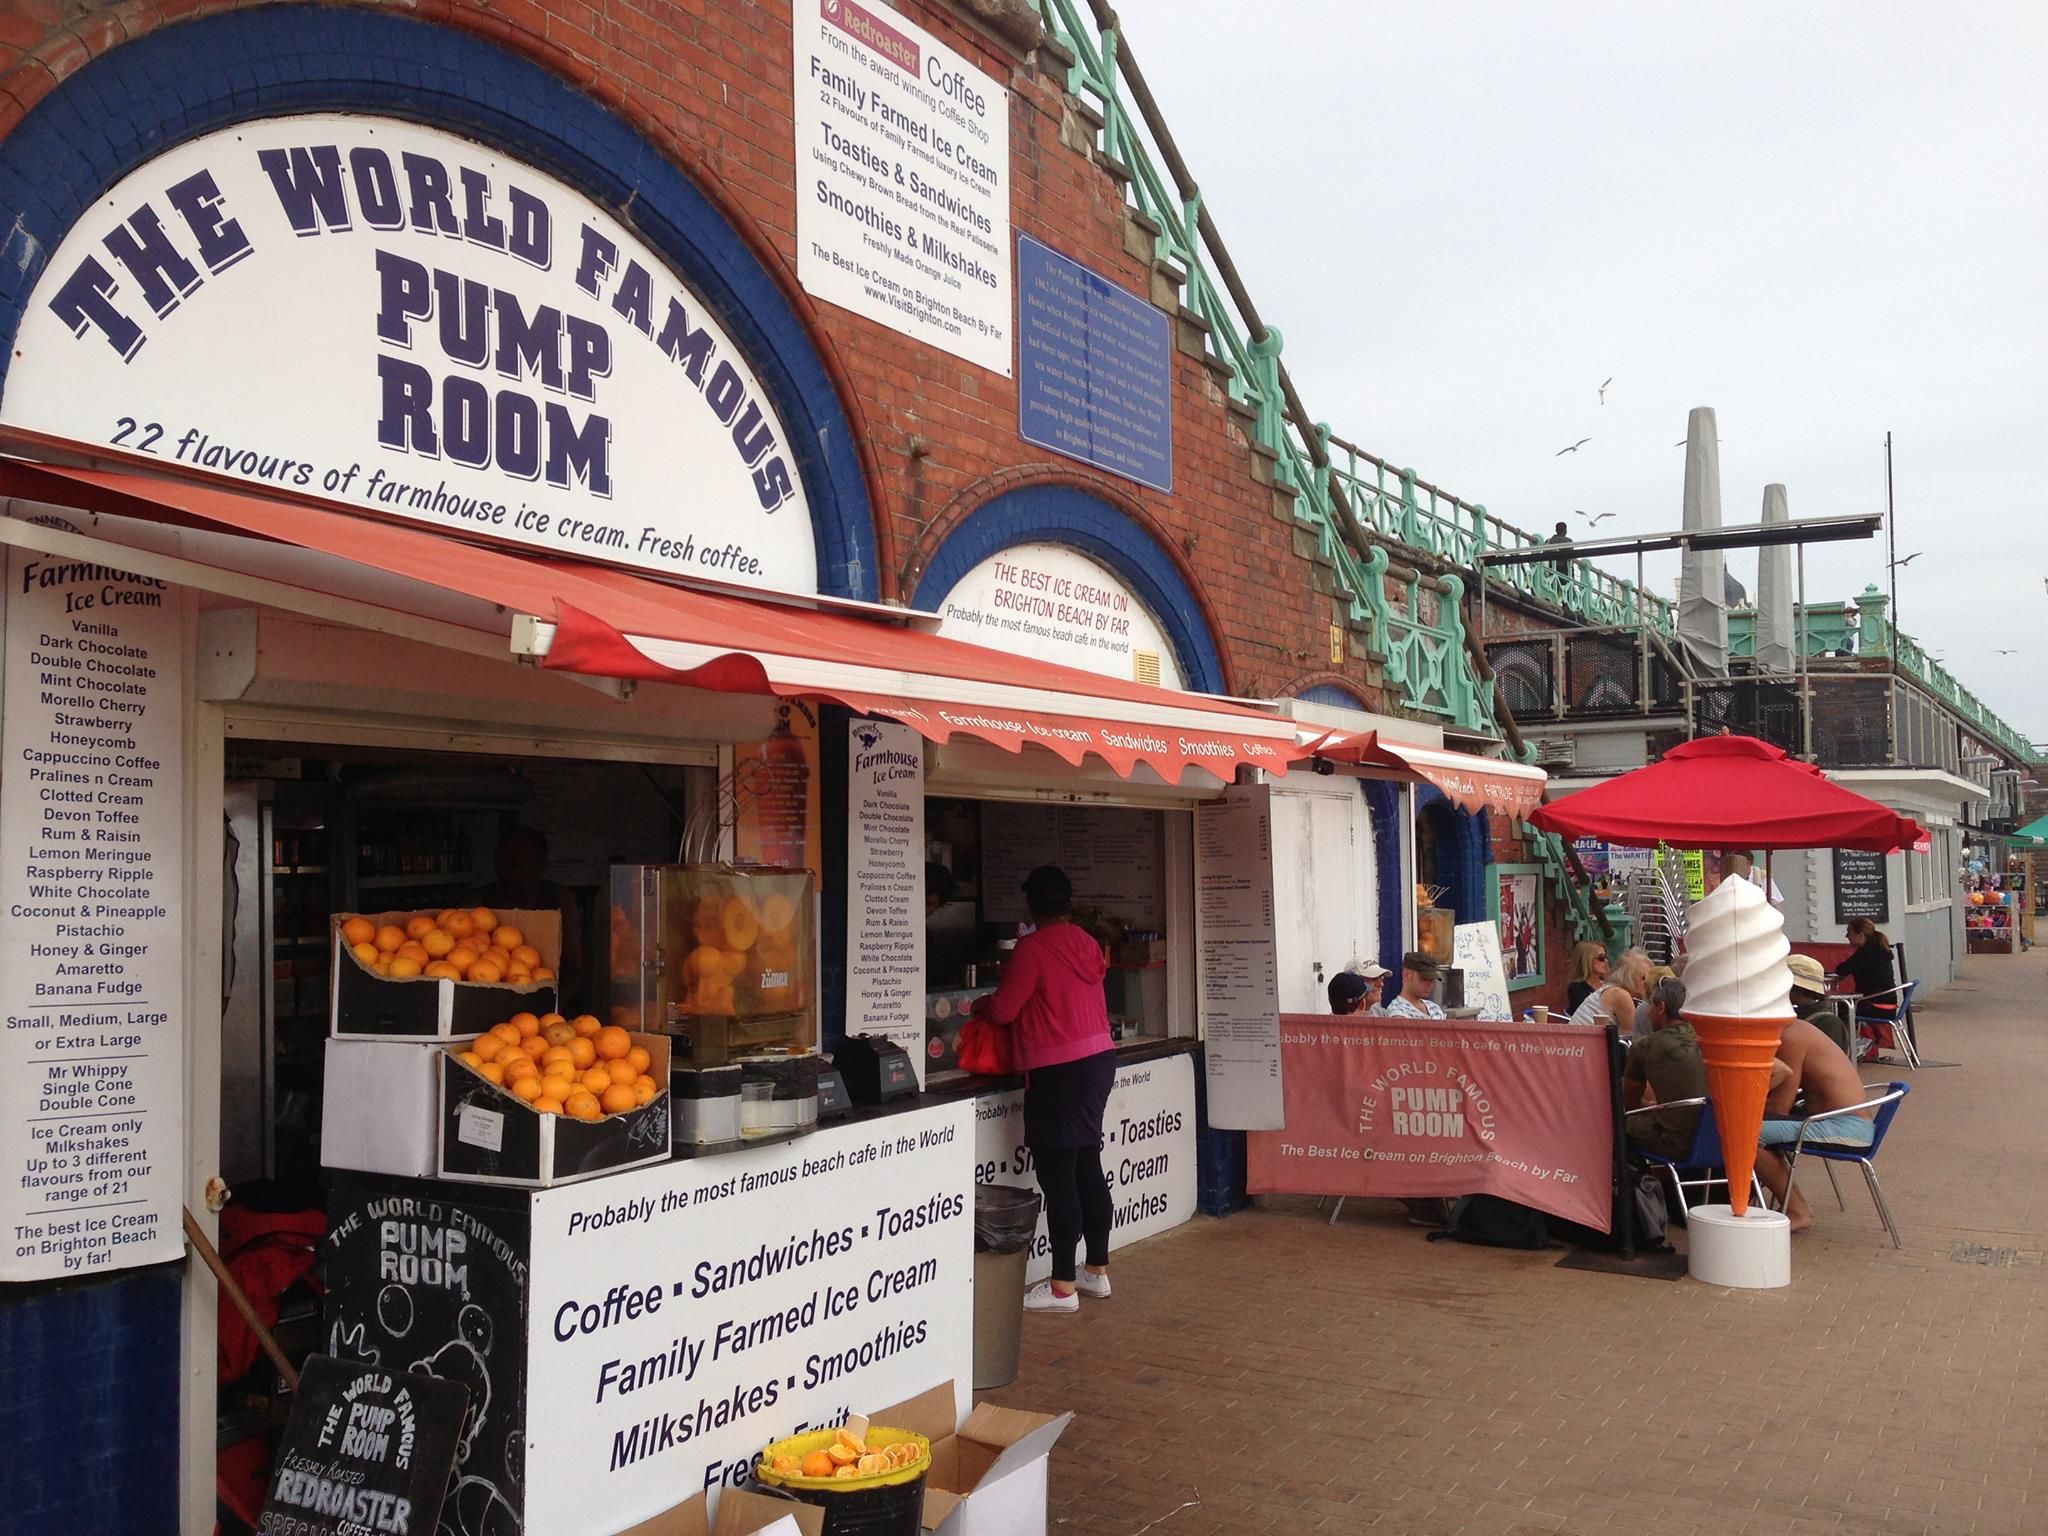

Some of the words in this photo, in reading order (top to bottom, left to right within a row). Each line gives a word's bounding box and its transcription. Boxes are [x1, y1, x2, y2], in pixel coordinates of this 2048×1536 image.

[843, 7, 916, 70] Redroaster
[821, 26, 847, 52] From
[850, 41, 867, 66] the
[870, 56, 899, 87] award
[901, 78, 936, 114] winning
[938, 98, 966, 130] Coffee
[968, 117, 989, 145] Shop
[927, 55, 986, 117] Coffee
[810, 55, 866, 110] Family
[871, 92, 927, 144] Farmed
[932, 130, 952, 157] Ice
[956, 144, 997, 186] Cream
[820, 91, 830, 105] 22
[832, 96, 867, 127] Flavours
[870, 116, 878, 133] of
[880, 121, 905, 151] Family
[907, 138, 934, 167] Farmed
[936, 154, 957, 181] luxury
[959, 168, 969, 186] Ice
[970, 177, 991, 198] Cream
[821, 121, 889, 177] Toasties
[895, 163, 905, 184] &
[910, 172, 992, 234] Sandwiches
[816, 180, 903, 241] Smoothies
[907, 226, 918, 248] &
[922, 236, 997, 289] Milkshakes
[863, 232, 892, 262] Freshly
[894, 246, 913, 268] Made
[915, 258, 941, 284] Orange
[943, 271, 962, 290] Juice
[811, 242, 830, 261] The
[833, 251, 854, 272] Best
[857, 263, 870, 279] Ice
[872, 270, 900, 294] Cream
[903, 285, 914, 298] on
[916, 291, 950, 318] Brighton
[953, 307, 977, 328] Beach
[979, 319, 988, 336] By
[990, 325, 1002, 340] Far
[864, 285, 962, 336] www.VisitBrighton.com
[49, 168, 255, 364] THE
[256, 144, 552, 272] WORLD
[573, 222, 796, 516] FAMOUS
[375, 248, 612, 403] PUMP
[376, 354, 613, 500] ROOM
[110, 416, 163, 456] 22
[176, 426, 314, 489] flavours
[322, 461, 359, 496] of
[366, 472, 506, 527] farmhouse
[514, 500, 550, 532] ice
[556, 513, 631, 551] cream.
[638, 527, 695, 562] Fresh
[699, 541, 764, 577] coffee.
[994, 562, 1017, 584] THE
[1021, 568, 1051, 592] BEST
[1053, 577, 1071, 597] ICE
[1073, 583, 1111, 609] CREAM
[1113, 594, 1128, 612] ON
[72, 620, 118, 637] Vanilla
[946, 604, 983, 628] Probably
[985, 613, 998, 627] the
[1001, 618, 1021, 633] most
[1022, 620, 1051, 637] famous
[1052, 627, 1073, 644] beach
[1074, 634, 1089, 647] cafe
[1089, 636, 1097, 647] in
[1099, 637, 1110, 651] the
[1111, 641, 1128, 654] world
[994, 589, 1053, 618] BRIGHTON
[1058, 602, 1092, 628] BEACH
[1095, 612, 1108, 631] BY
[1111, 616, 1129, 637] FAR
[40, 634, 73, 650] Dark
[78, 639, 148, 659] Chocolate
[41, 673, 72, 688] Mint
[77, 677, 146, 696] Chocolate
[50, 732, 136, 749] Honeycomb
[55, 712, 132, 733] Strawberry
[939, 711, 1026, 735] Farmhouse
[1027, 719, 1052, 738] Ice
[1053, 729, 1092, 744] cream
[1101, 729, 1168, 754] Sandwiches
[1178, 738, 1234, 758] Smoothies
[23, 749, 111, 771] Cappuccino
[115, 756, 160, 769] Coffee
[856, 750, 918, 772] Farmhouse
[873, 771, 886, 784] Ice
[888, 766, 915, 779] Cream
[40, 789, 93, 803] Clotted
[98, 791, 143, 806] Cream
[44, 808, 91, 822] Devon
[95, 810, 139, 824] Toffee
[869, 860, 905, 869] Honeycomb
[56, 924, 124, 938] Pistachio
[35, 982, 92, 995] Banana
[97, 981, 142, 997] Fudge
[55, 963, 124, 976] Amaretto
[43, 1080, 90, 1097] Single
[95, 1078, 133, 1092] Cone
[48, 1066, 68, 1079] Mr
[71, 1063, 128, 1078] Whippy
[1121, 1077, 1131, 1087] the
[1133, 1071, 1150, 1086] World
[1359, 1096, 1377, 1134] THE
[1372, 1061, 1438, 1092] WORLD
[1446, 1066, 1496, 1142] FAMOUS
[1391, 1086, 1464, 1114] PUMP
[1120, 1111, 1182, 1146] Toasties
[1392, 1111, 1464, 1138] ROOM
[568, 1195, 656, 1237] Probably
[660, 1190, 688, 1214] the
[693, 1179, 737, 1207] most
[739, 1162, 797, 1194] famous
[802, 1146, 845, 1179] beach
[848, 1143, 877, 1167] cafe
[880, 1140, 892, 1159] in
[895, 1134, 916, 1154] the
[918, 1124, 955, 1149] World
[1119, 1153, 1168, 1185] Cream
[1281, 1144, 1305, 1156] The
[1308, 1145, 1338, 1158] Best
[1341, 1148, 1360, 1159] Ice
[1363, 1148, 1405, 1162] Cream
[1409, 1153, 1424, 1162] on
[1429, 1151, 1482, 1166] Brighton
[1486, 1151, 1528, 1172] Beach
[1531, 1164, 1551, 1178] by
[1553, 1168, 1578, 1184] Far
[329, 1212, 362, 1247] THE
[367, 1198, 443, 1222] WORLD
[450, 1209, 528, 1286] FAMOUS
[380, 1221, 467, 1259] PUMP
[380, 1251, 467, 1291] ROOM
[553, 1284, 662, 1343] Coffee
[691, 1223, 854, 1299] Sandwiches
[876, 1191, 965, 1241] Toasties
[596, 1336, 705, 1405] Family
[712, 1298, 816, 1362] Farmed
[823, 1286, 858, 1320] Ice
[866, 1257, 938, 1304] Cream
[609, 1376, 779, 1472] Milkshakes
[803, 1316, 927, 1391] Smoothies
[349, 1402, 396, 1432] PUMP
[340, 1425, 390, 1462] ROOM
[274, 1468, 412, 1536] REDROASTER
